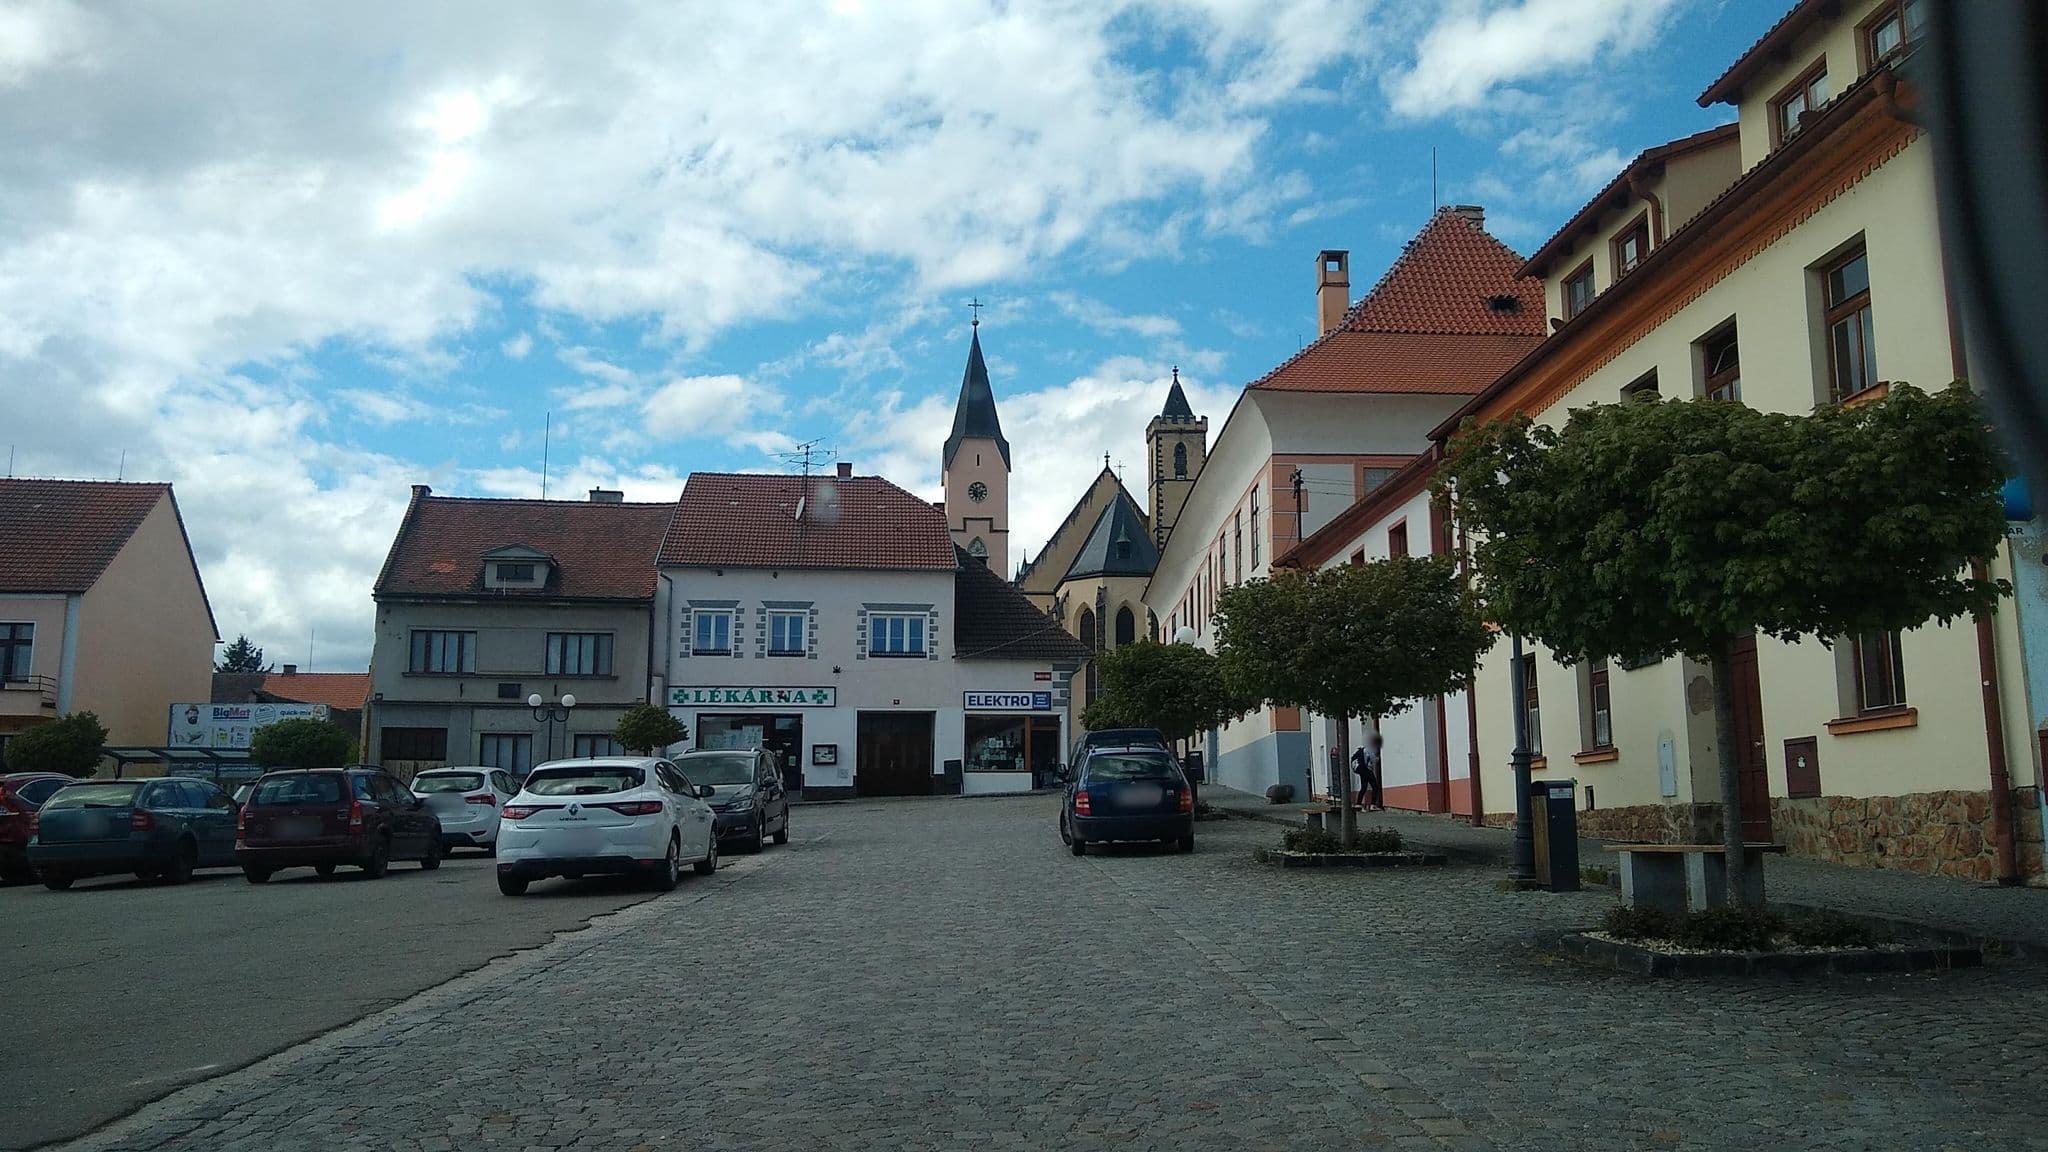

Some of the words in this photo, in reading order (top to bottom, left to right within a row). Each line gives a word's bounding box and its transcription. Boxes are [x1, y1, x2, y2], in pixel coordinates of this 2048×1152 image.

[694, 687, 808, 703] LÉKÁRNA
[967, 695, 1030, 706] ELEKTRO
[212, 707, 251, 717] BigMat
